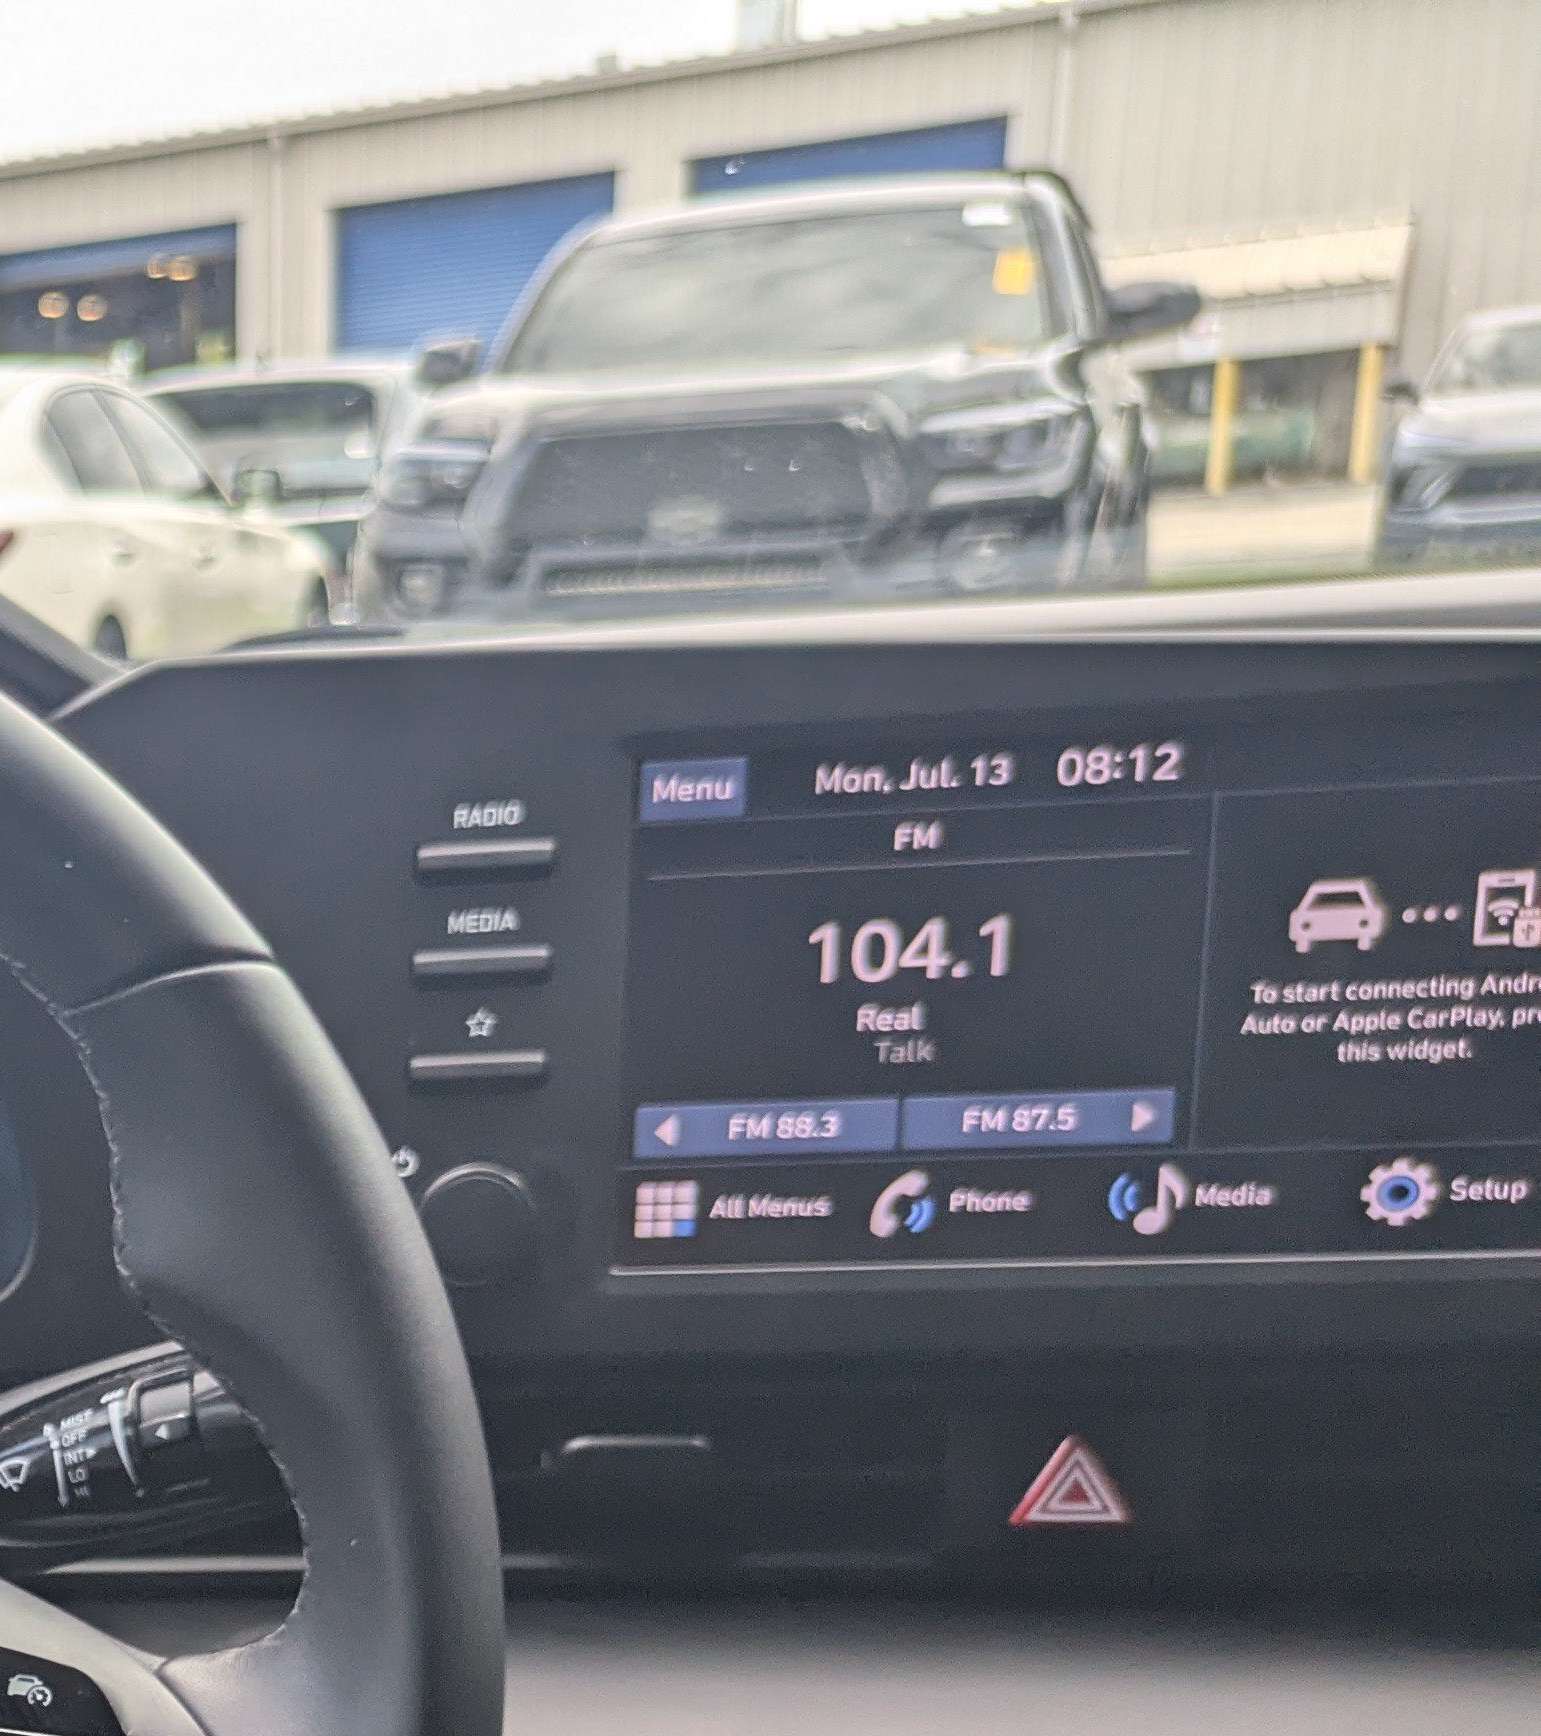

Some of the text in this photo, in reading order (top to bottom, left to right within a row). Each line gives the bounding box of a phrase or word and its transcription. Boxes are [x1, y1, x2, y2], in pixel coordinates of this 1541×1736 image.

[899, 754, 963, 790] Jul.
[970, 750, 1014, 787] 13
[1057, 741, 1185, 787] 08:12
[652, 773, 735, 804] Menu
[453, 799, 524, 829] RADIO
[893, 820, 945, 851] FM
[446, 907, 519, 935] MEDIA
[809, 913, 1014, 984] 104.1
[1250, 979, 1278, 1003] To
[1282, 980, 1341, 1003] start
[1345, 974, 1475, 1001] connecting
[856, 1001, 925, 1032] Real
[1240, 1012, 1295, 1035] Auto
[1300, 1014, 1328, 1033] or
[1333, 1009, 1402, 1035] Apple
[874, 1036, 938, 1065] Talk
[1337, 1038, 1473, 1064] this widget.
[728, 1110, 842, 1140] FM 88.3
[962, 1103, 1077, 1133] FM 87.5
[948, 1188, 1032, 1213] Phone
[1195, 1183, 1273, 1207] Media
[1450, 1175, 1528, 1205] Setup
[709, 1193, 832, 1219] All Menus
[60, 1409, 93, 1430] MIST
[61, 1430, 87, 1448] OFF
[63, 1448, 86, 1466] INT
[68, 1467, 88, 1484] LO
